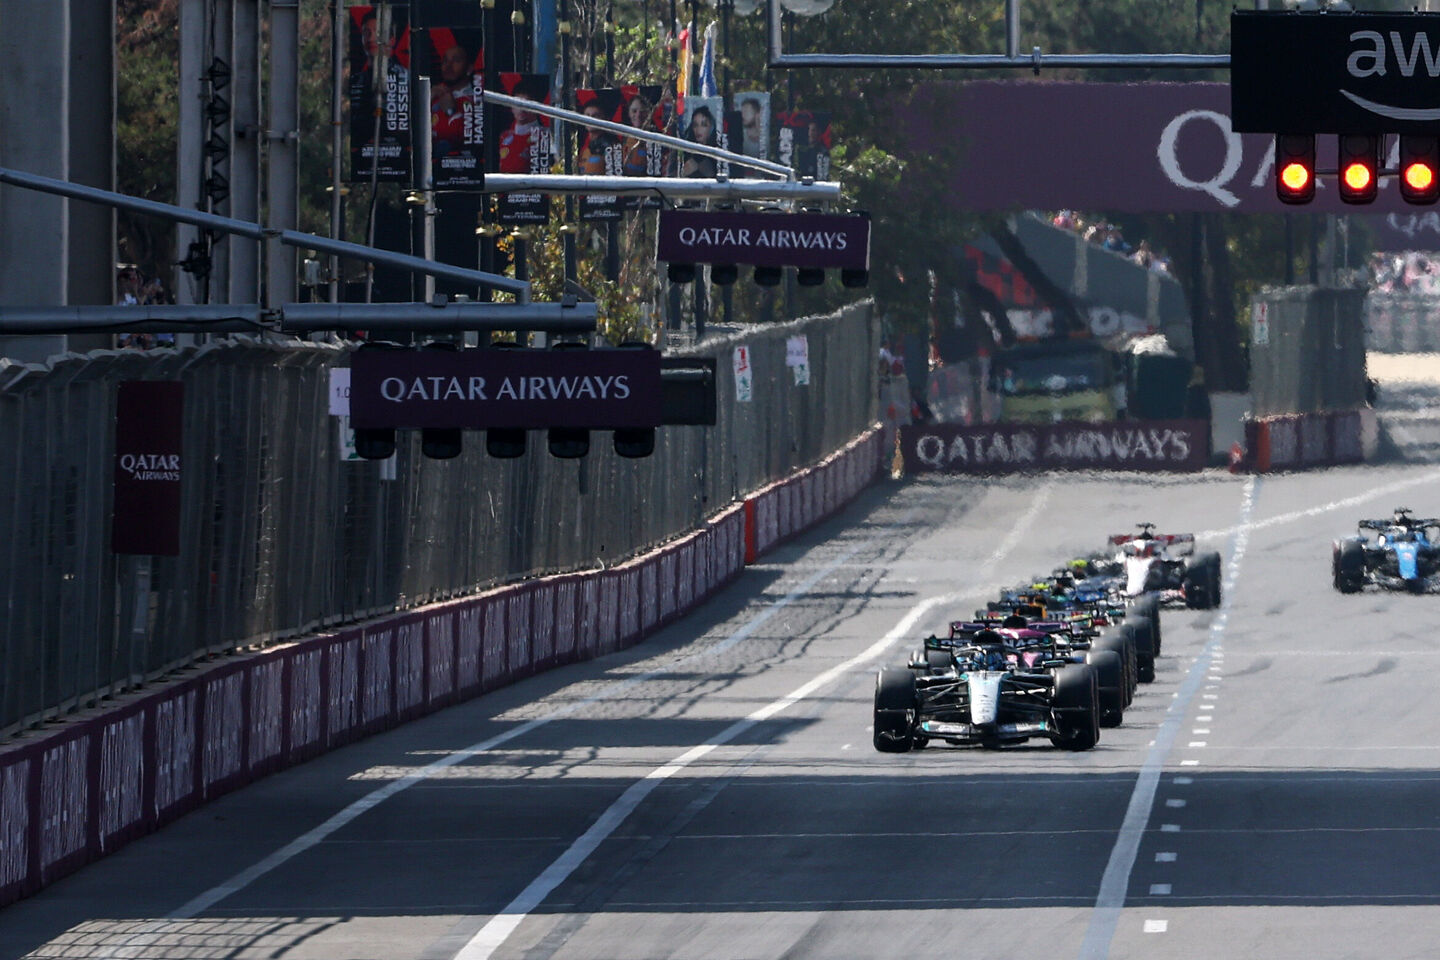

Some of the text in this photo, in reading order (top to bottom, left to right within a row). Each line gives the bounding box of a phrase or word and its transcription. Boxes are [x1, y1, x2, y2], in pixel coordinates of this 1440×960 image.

[387, 73, 397, 131] GEORGE
[399, 67, 409, 131] RUSSELL
[473, 74, 484, 145] HAMILTON
[463, 102, 473, 145] LEWIS
[530, 126, 540, 175] HARLES
[679, 227, 848, 250] QATAR AIRWAYS
[380, 375, 631, 402] QATAR AIRWAYS
[120, 454, 180, 473] QATAR
[916, 432, 1037, 468] QATAR
[124, 470, 180, 481] AIRWAYS
